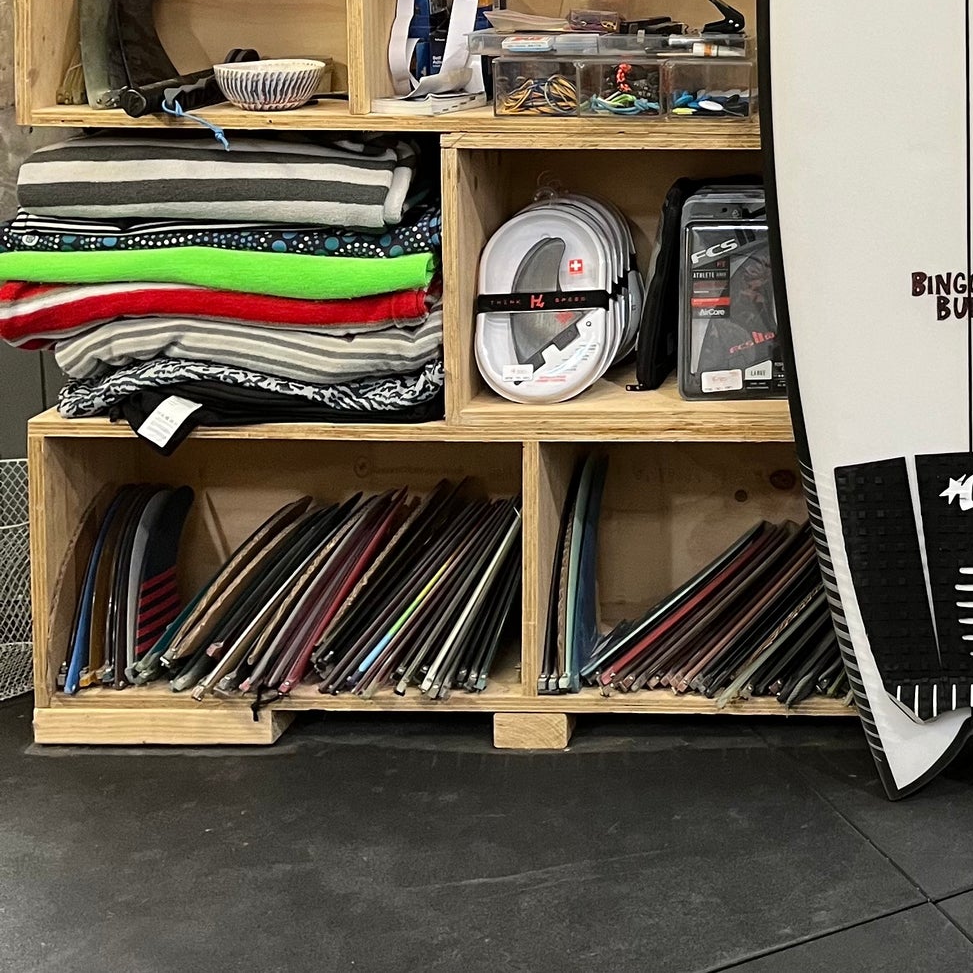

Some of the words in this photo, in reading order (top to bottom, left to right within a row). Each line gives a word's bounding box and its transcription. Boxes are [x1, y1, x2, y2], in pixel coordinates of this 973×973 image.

[690, 238, 738, 265] FCS
[699, 308, 725, 316] AirCore
[729, 340, 754, 353] FCS
